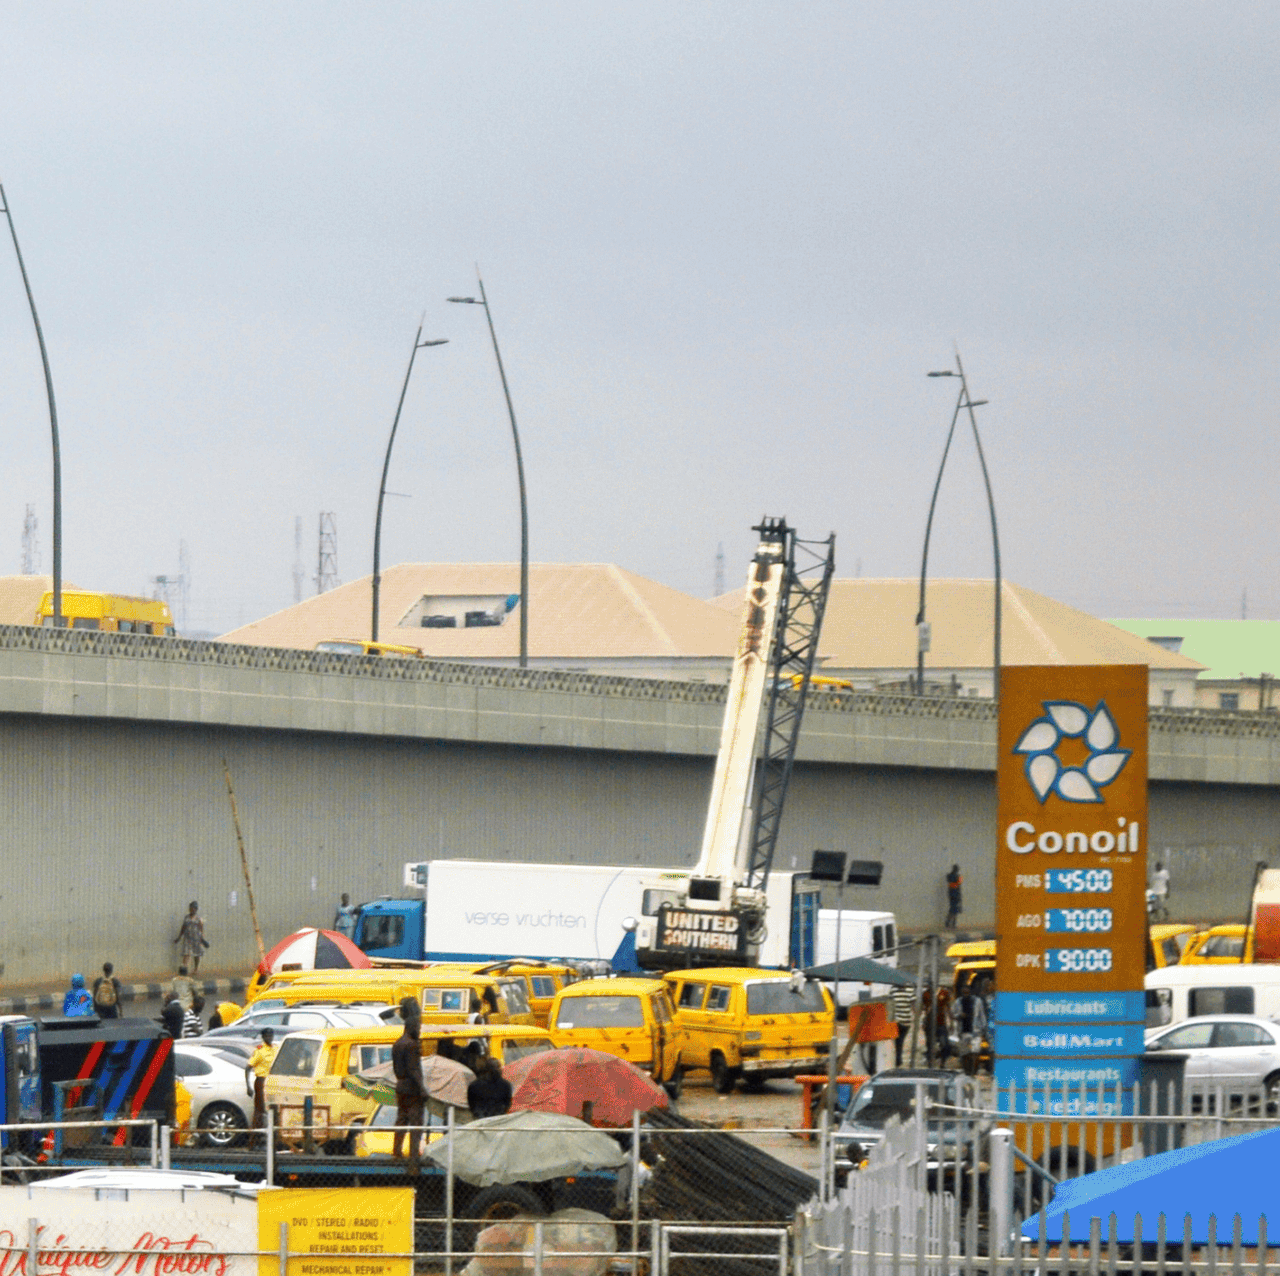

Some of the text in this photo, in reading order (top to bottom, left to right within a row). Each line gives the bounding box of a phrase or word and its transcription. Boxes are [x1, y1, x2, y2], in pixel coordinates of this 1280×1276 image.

[1006, 817, 1139, 854] Conoil
[464, 909, 587, 928] verse vruchten
[665, 911, 739, 932] UNITED
[663, 930, 738, 951] SOUTHERN
[1026, 1000, 1108, 1014] Lubricants
[1027, 1067, 1121, 1081] Restaurants
[301, 1265, 384, 1275] MECHANICAL REPAIR
